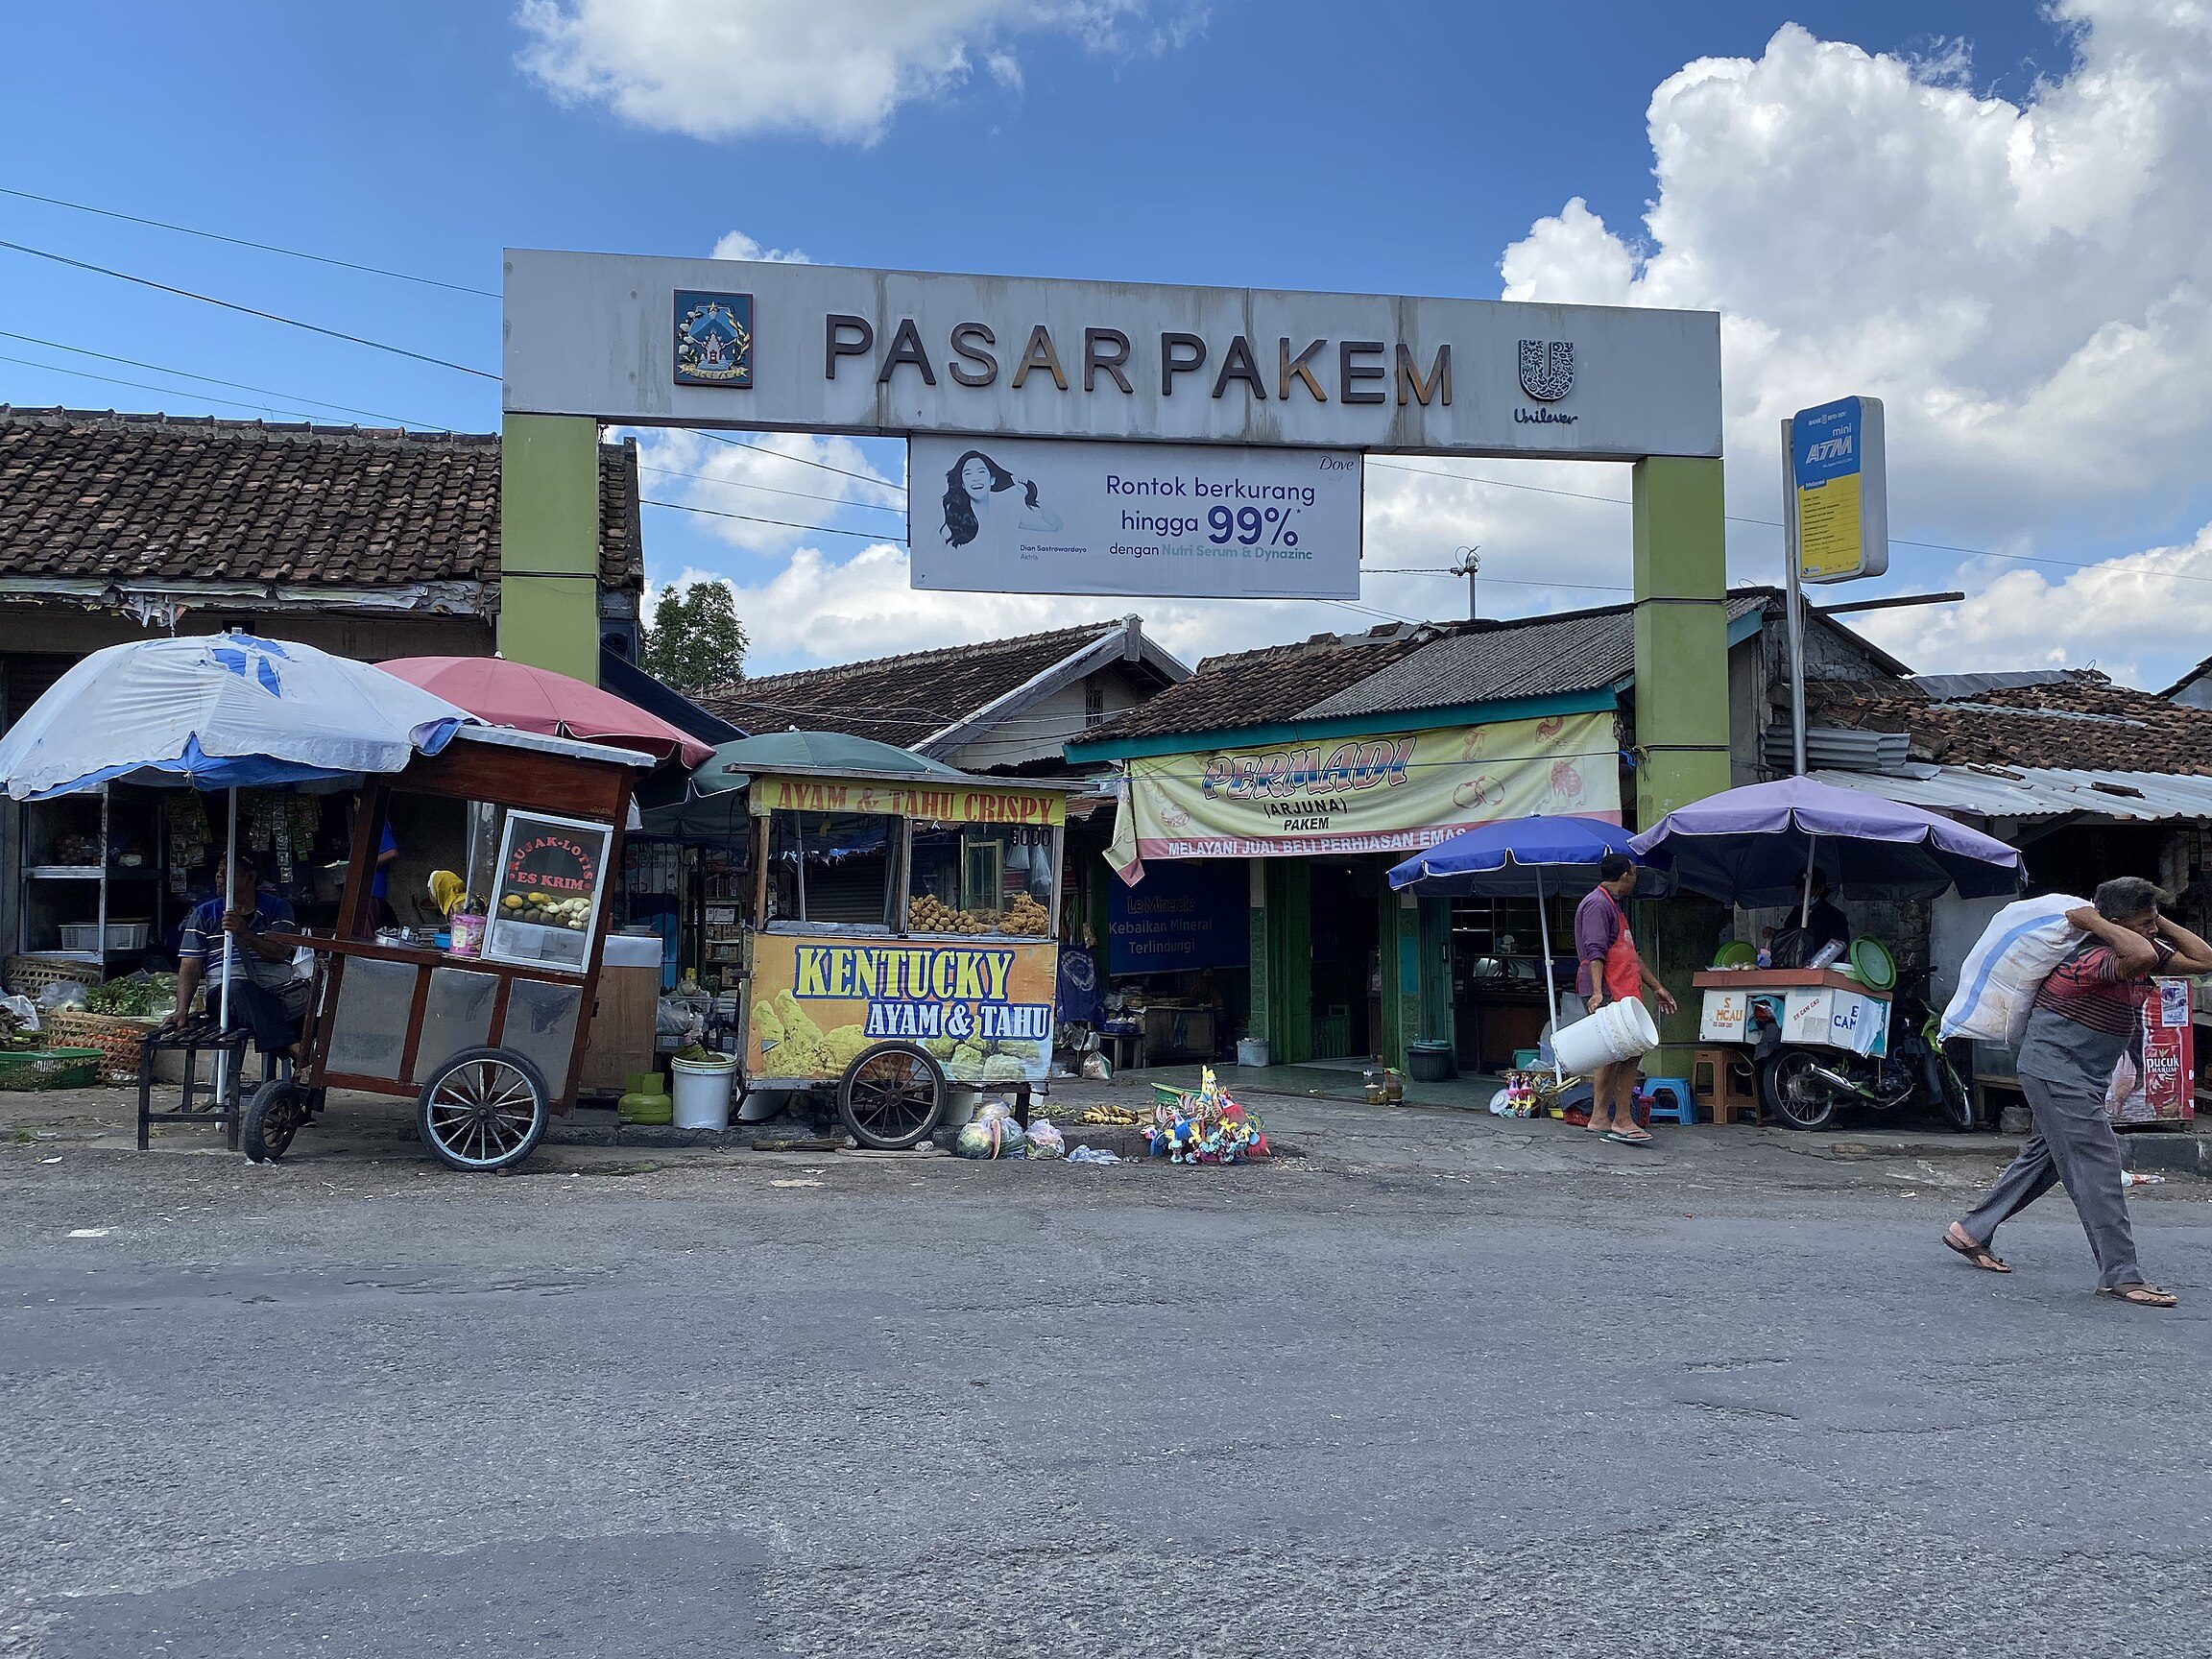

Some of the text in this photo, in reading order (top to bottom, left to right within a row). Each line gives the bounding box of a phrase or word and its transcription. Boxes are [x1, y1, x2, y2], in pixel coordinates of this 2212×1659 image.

[825, 313, 1453, 406] PASAR PAKEM
[1513, 407, 1579, 424] Unilever
[1832, 422, 1852, 437] mini
[1805, 435, 1853, 464] ATM
[1319, 455, 1355, 471] Dove
[1106, 474, 1315, 507] Rontok berkurang
[1120, 509, 1199, 537] hingga
[1109, 541, 1313, 563] dengan Nutri Serum & Dynazinc
[1201, 735, 1417, 801] PERMADI
[778, 781, 1055, 826] AYAM & TAHU CRISPY
[1262, 798, 1348, 818] (ARJUNA)
[1284, 817, 1330, 831] PAKEM
[1167, 841, 1238, 857] MELAYANI
[1241, 838, 1279, 855] JUAL
[1282, 837, 1316, 854] BELI
[1323, 831, 1414, 853] PERHIASAN
[517, 871, 584, 891] ES KRIM
[1126, 894, 1195, 914] Le Minerale
[1109, 917, 1213, 935] Kebaikan Mineral
[1127, 938, 1196, 954] Terlindungi
[794, 946, 1014, 1000] KENTUCKY
[867, 1002, 1049, 1038] AYAM & TAHU
[2146, 1054, 2180, 1073] pucuk
